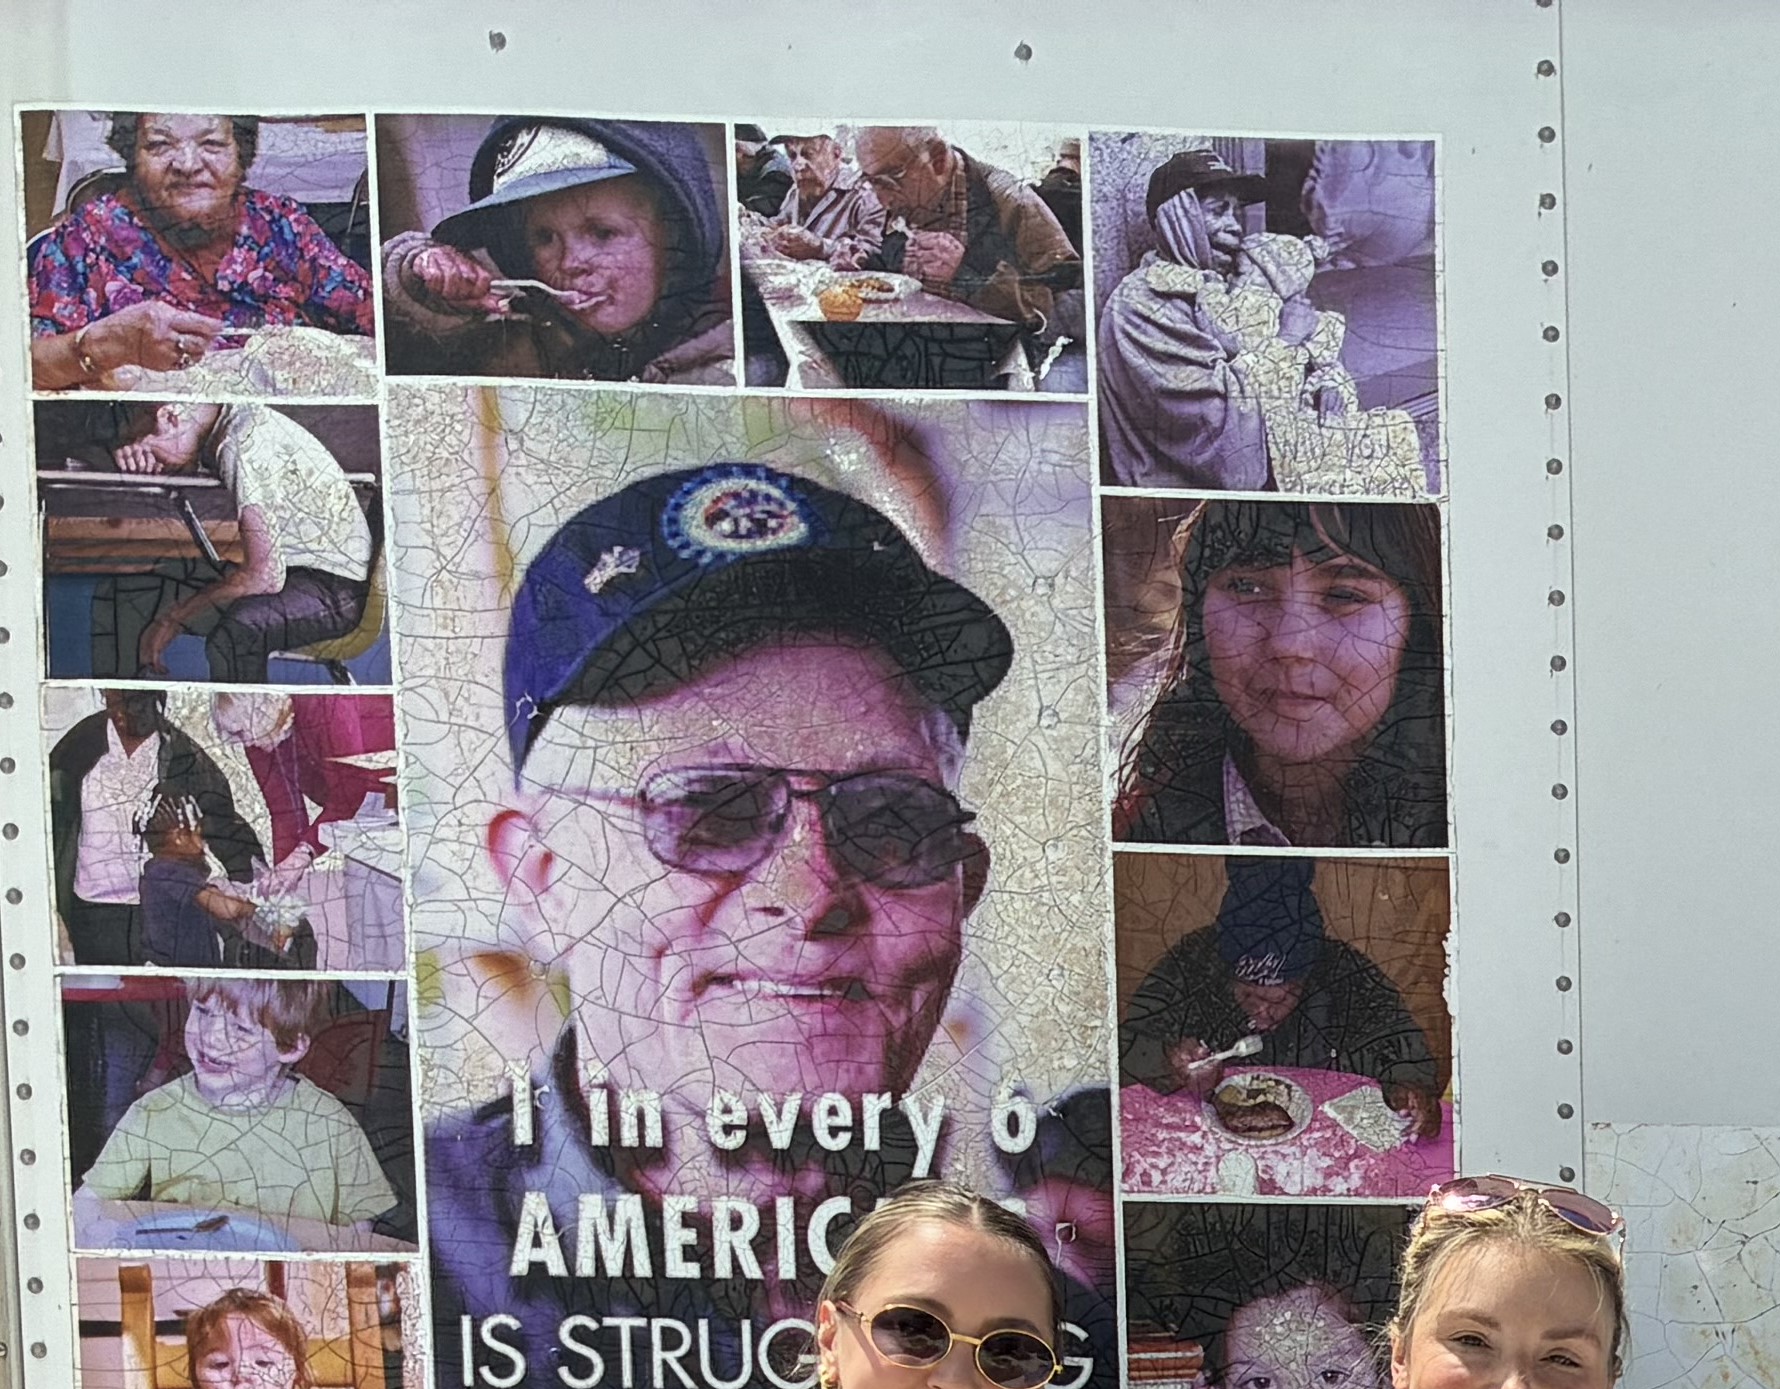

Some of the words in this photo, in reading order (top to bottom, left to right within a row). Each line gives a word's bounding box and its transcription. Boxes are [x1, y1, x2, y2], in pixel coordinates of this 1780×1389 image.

[588, 1060, 663, 1149] in
[708, 1091, 947, 1178] every
[989, 1088, 1038, 1154] 6
[460, 1313, 522, 1389] IS
